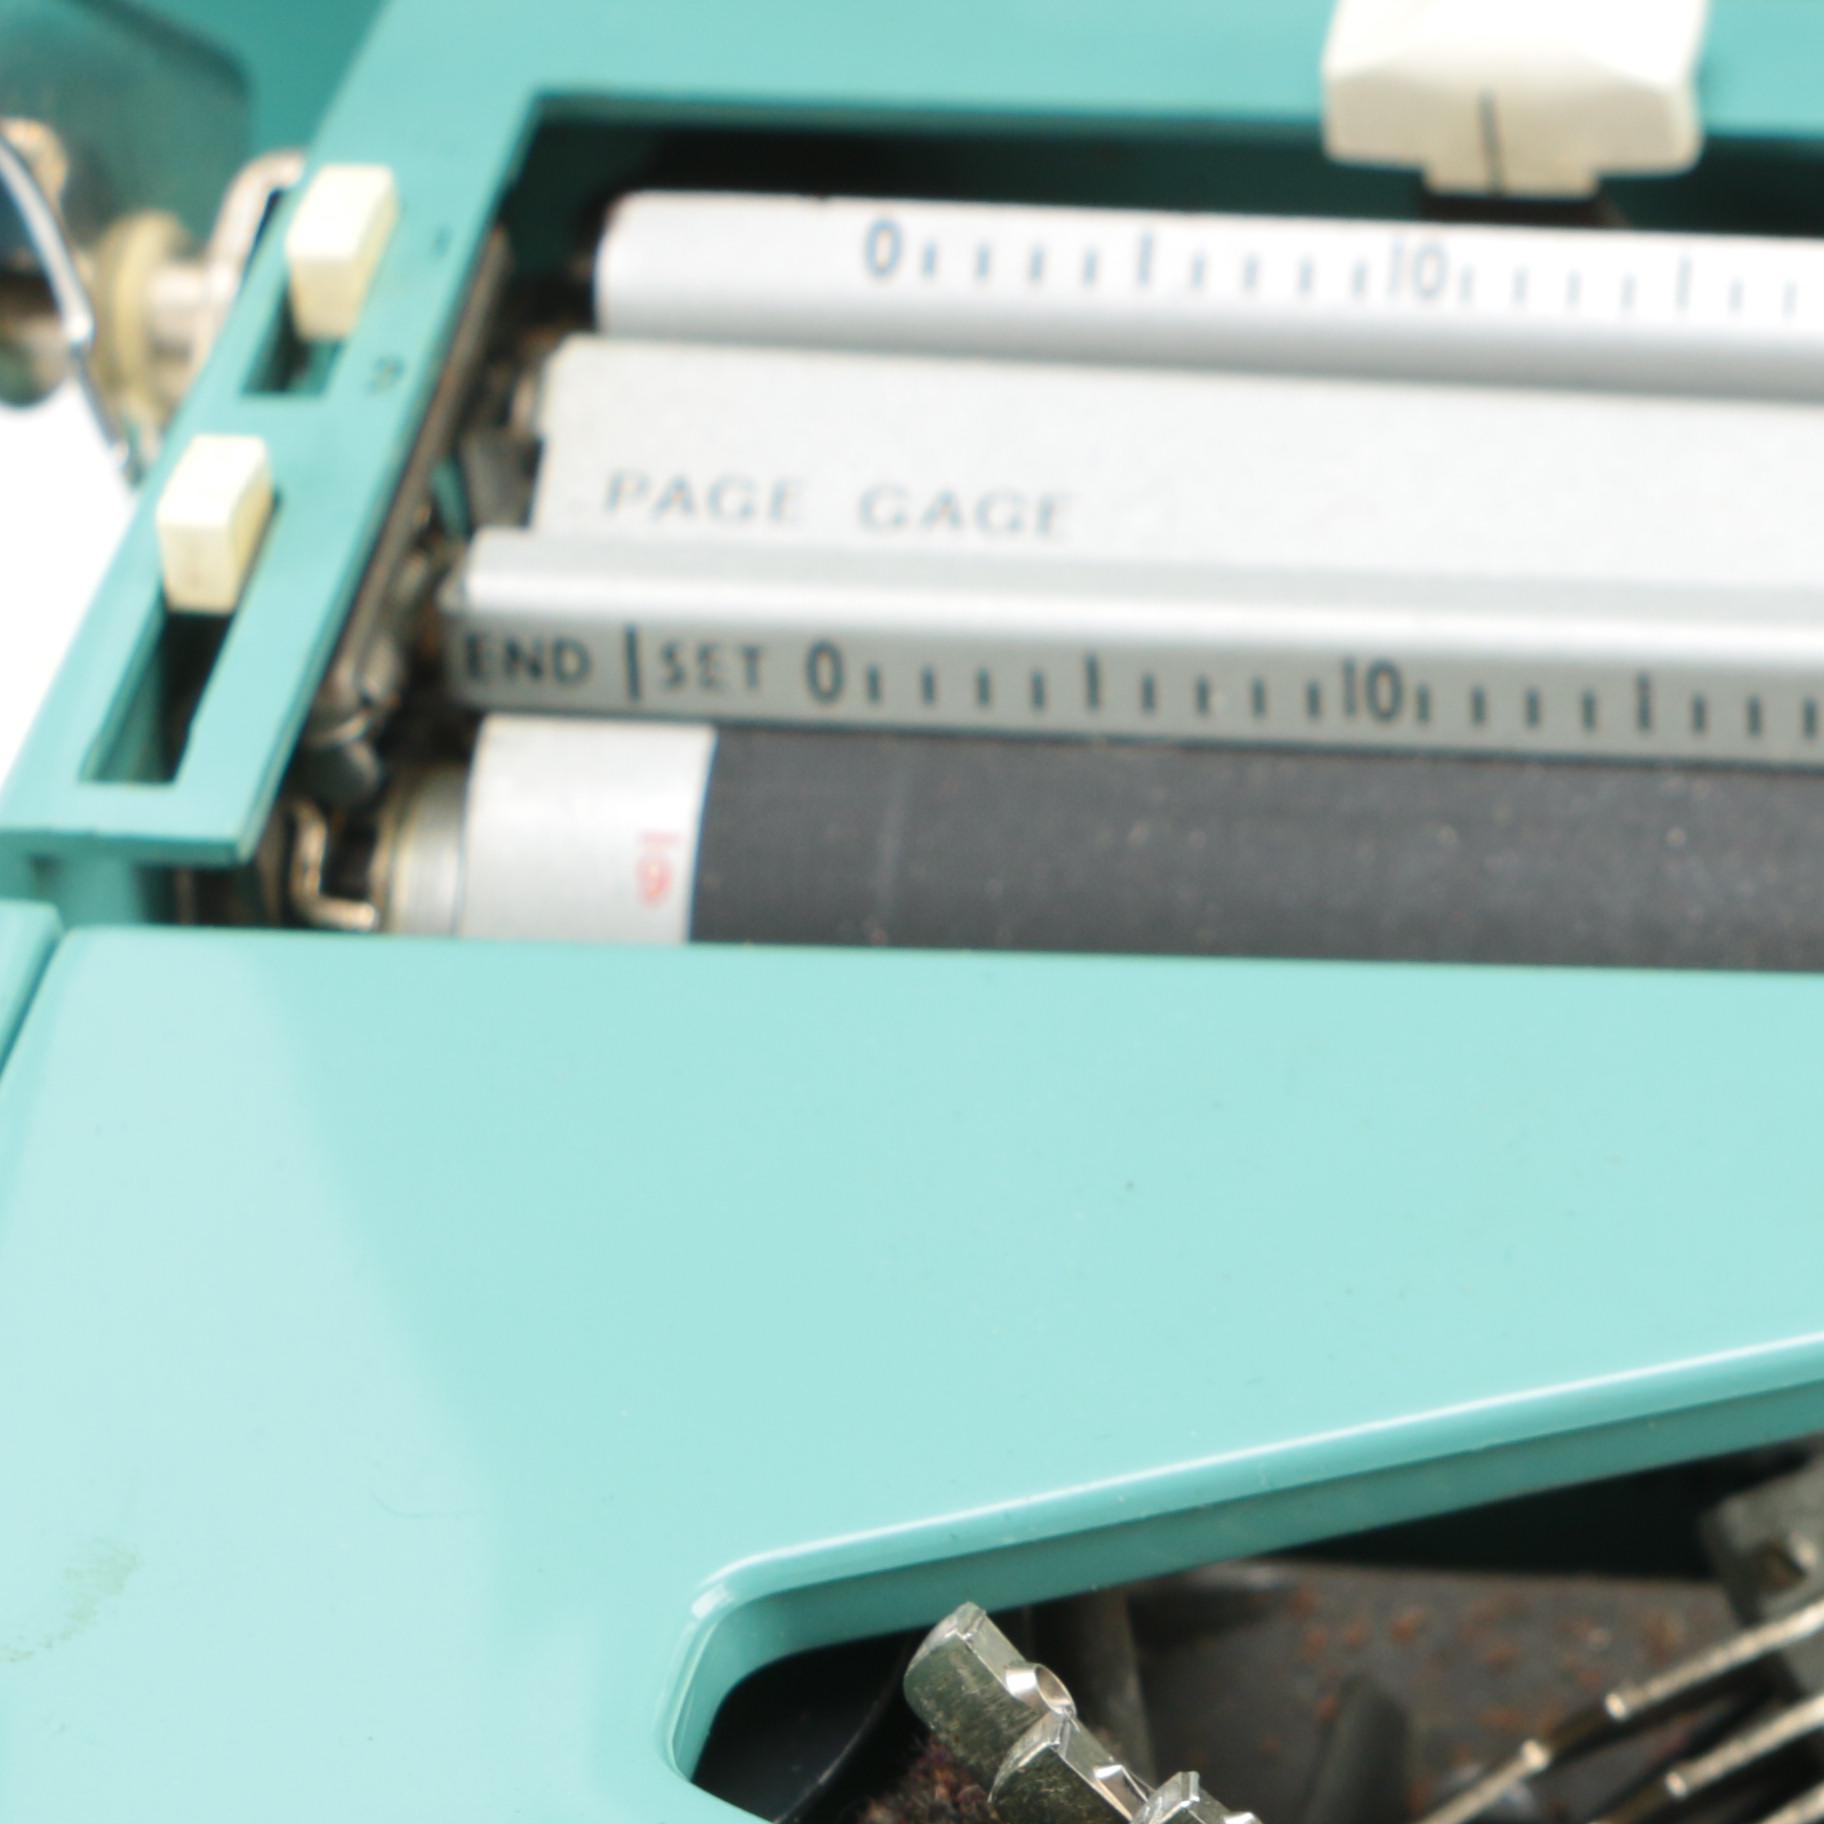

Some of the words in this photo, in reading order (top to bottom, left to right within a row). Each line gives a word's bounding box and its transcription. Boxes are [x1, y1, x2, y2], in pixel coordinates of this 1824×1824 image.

[865, 217, 902, 280] 0
[1388, 236, 1448, 300] 10
[604, 467, 809, 525] PAGE
[857, 482, 1079, 540] GAGE
[464, 632, 594, 686] END
[660, 640, 765, 694] SET
[805, 637, 845, 704] 0
[1346, 658, 1401, 725] 10
